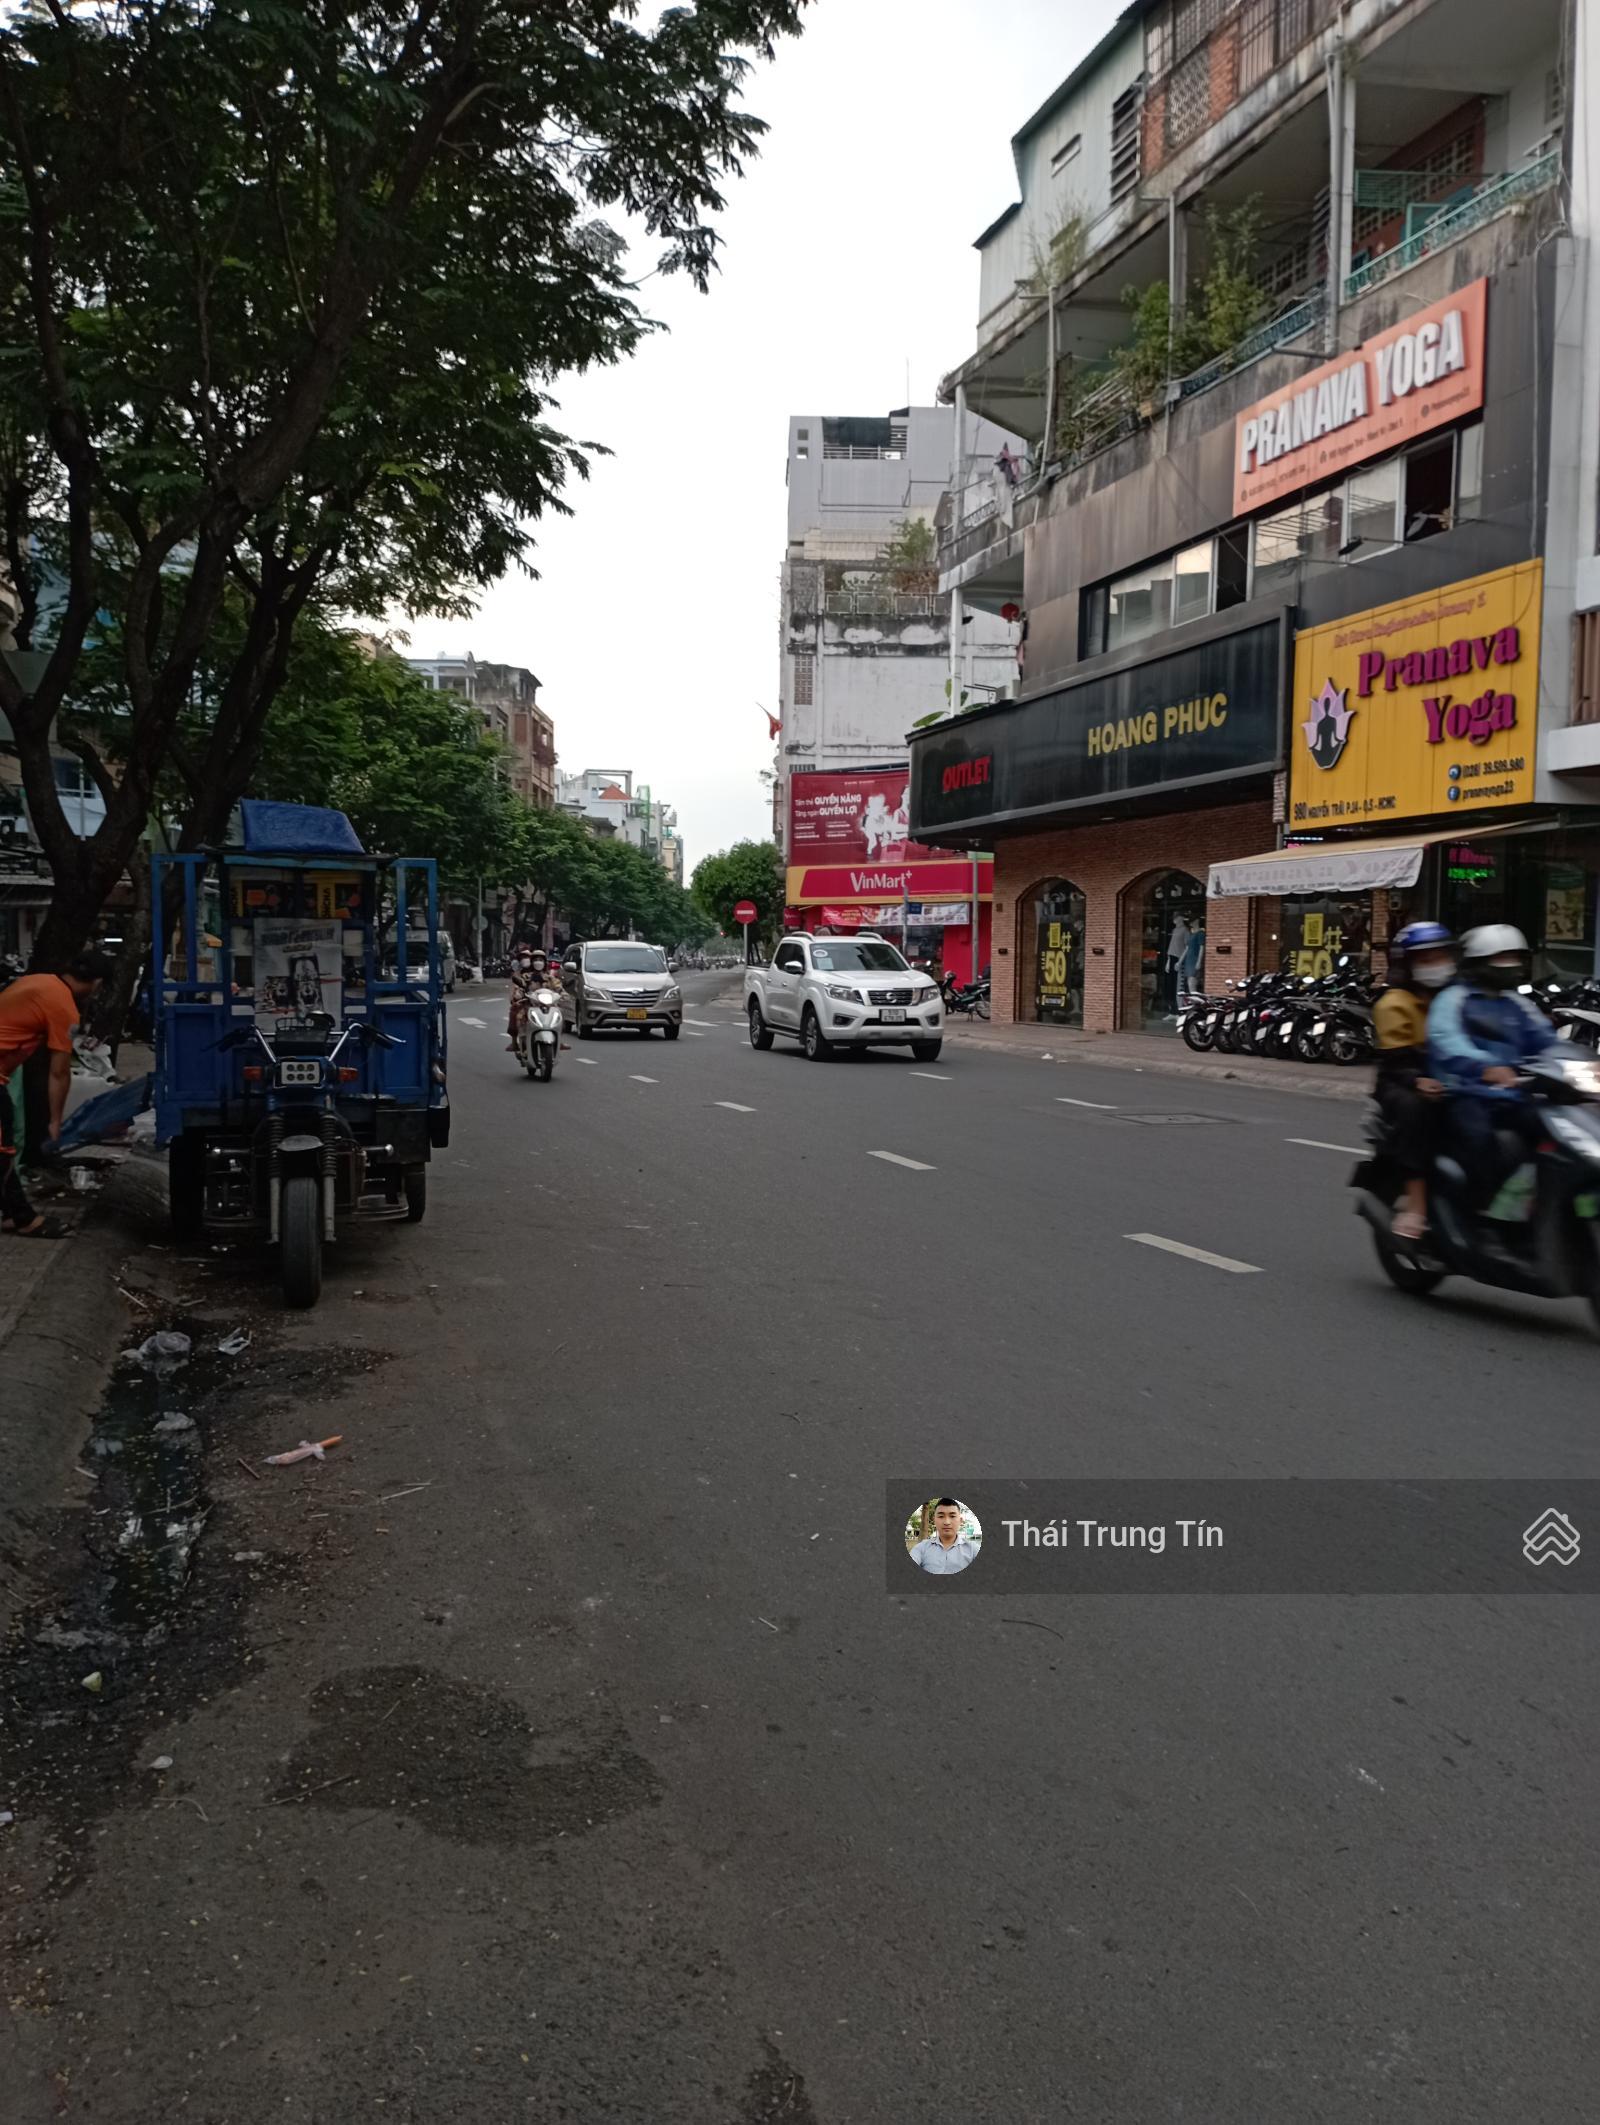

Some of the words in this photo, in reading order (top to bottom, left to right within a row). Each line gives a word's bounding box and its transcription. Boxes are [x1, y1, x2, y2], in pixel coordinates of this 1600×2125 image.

[1240, 361, 1369, 474] PRANAVA
[1375, 310, 1466, 406] YOGA
[1357, 626, 1520, 698] Pranava
[1088, 712, 1157, 757] HOANG
[1164, 693, 1228, 738] PHUC
[1422, 689, 1518, 746] Yoga
[943, 756, 991, 793] OUTLET
